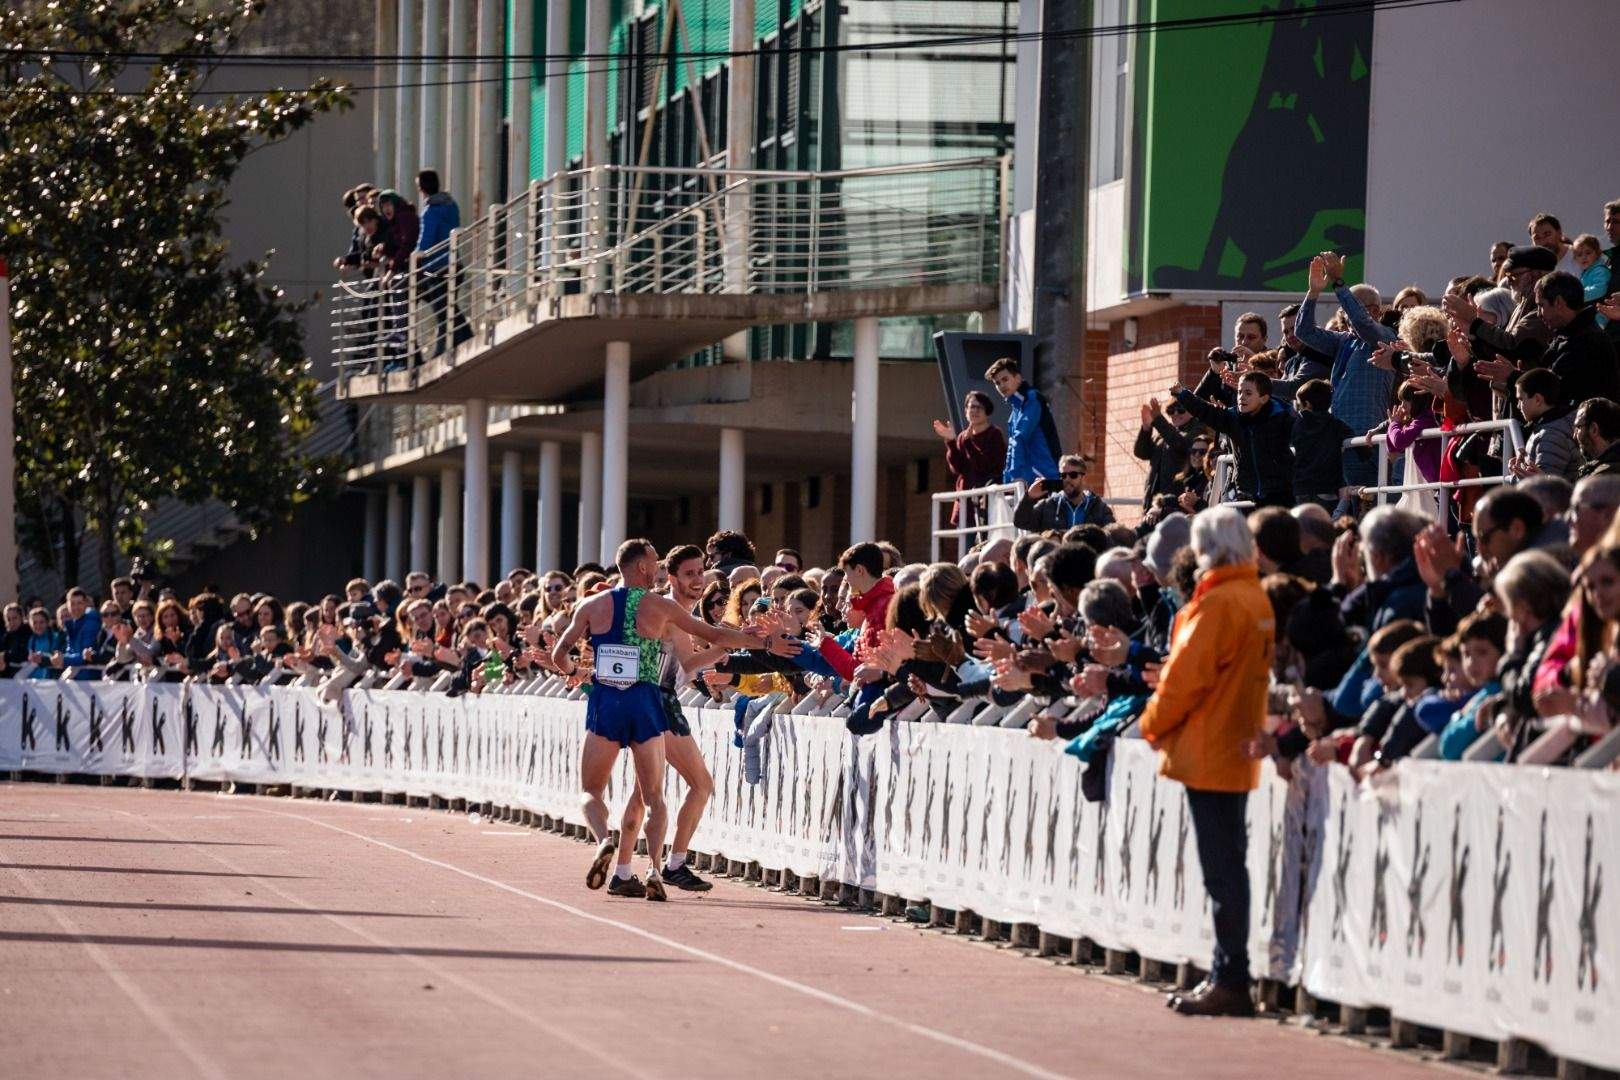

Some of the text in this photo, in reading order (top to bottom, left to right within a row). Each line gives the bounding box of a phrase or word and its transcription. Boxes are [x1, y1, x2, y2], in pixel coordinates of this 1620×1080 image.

[600, 648, 637, 657] kutxabank
[613, 662, 623, 674] 6
[21, 692, 165, 755] k k k k k
